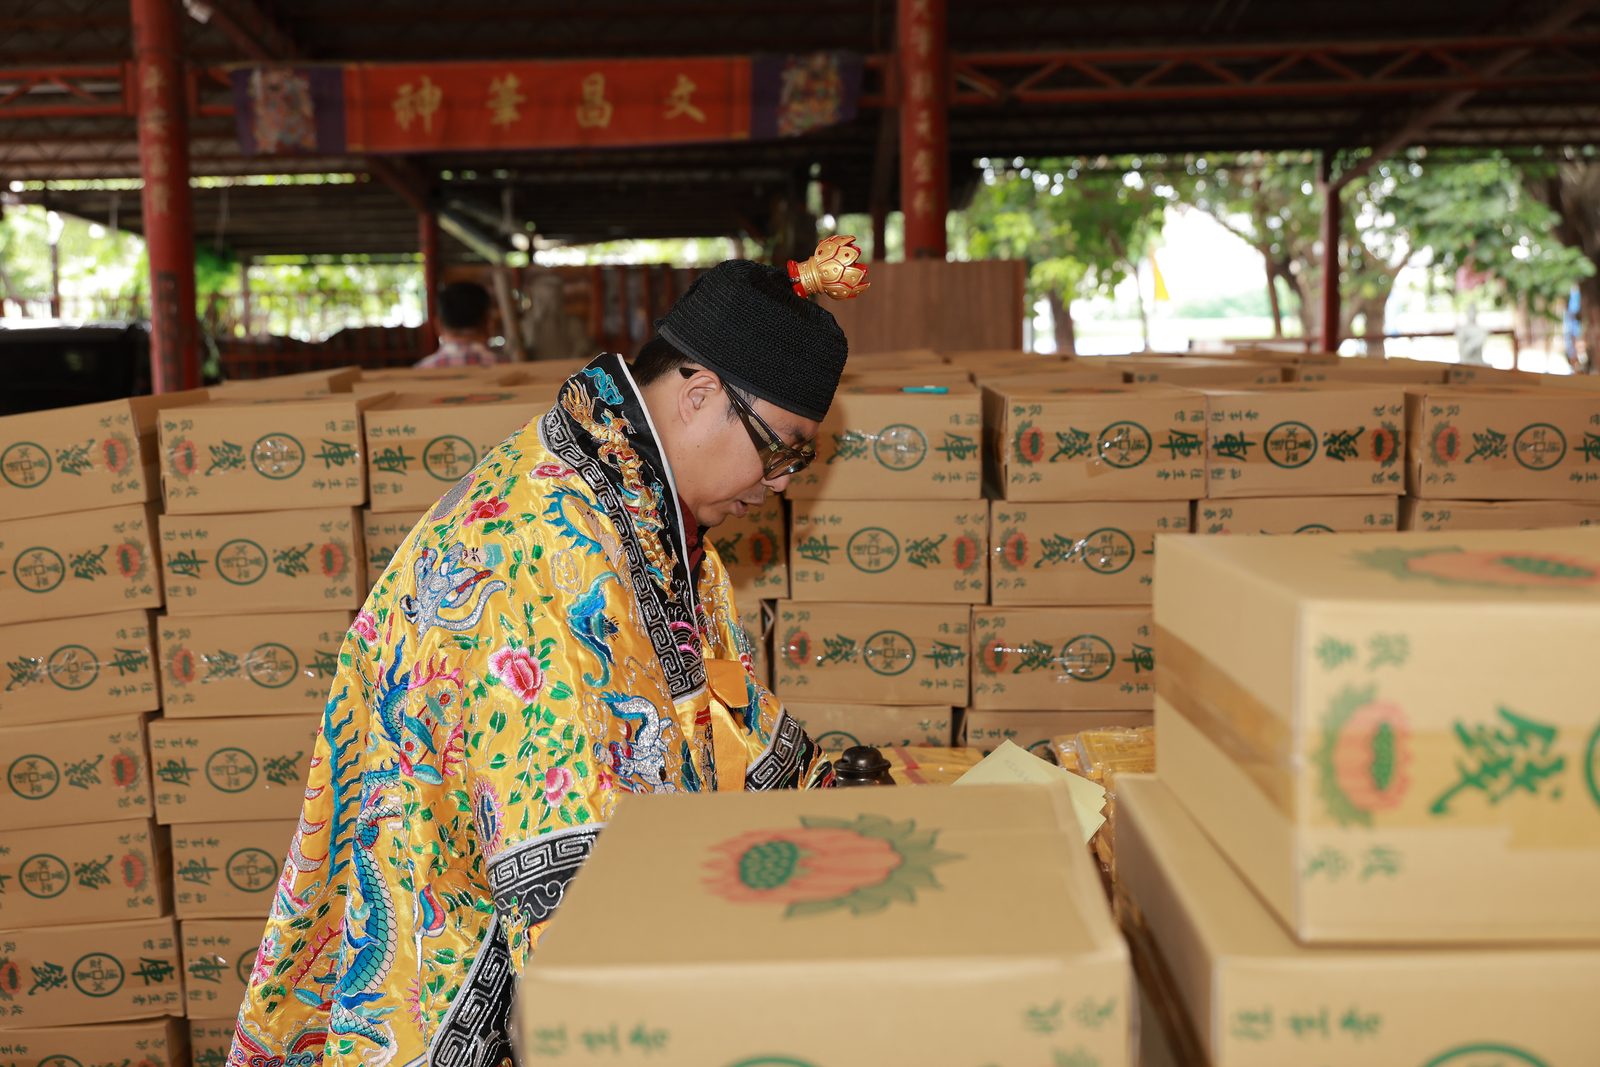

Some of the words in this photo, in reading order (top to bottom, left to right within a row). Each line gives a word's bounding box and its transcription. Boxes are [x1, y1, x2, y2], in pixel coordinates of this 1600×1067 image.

[57, 439, 97, 476] 錢
[204, 440, 247, 477] 錢
[314, 438, 360, 469] 庫
[935, 432, 978, 462] 庫
[1048, 427, 1093, 465] 錢
[1159, 429, 1203, 459] 庫
[1211, 431, 1257, 462] 庫
[1323, 424, 1367, 462] 錢
[1463, 427, 1508, 465] 錢
[372, 446, 416, 477] 庫
[68, 543, 110, 583] 錢
[166, 548, 208, 579] 庫
[272, 542, 315, 578] 錢
[795, 535, 840, 565] 庫
[905, 531, 949, 569] 錢
[1033, 532, 1077, 570] 錢
[108, 645, 149, 678] 庫
[816, 634, 858, 669] 錢
[925, 640, 967, 670] 庫
[1012, 639, 1056, 676] 錢
[63, 752, 105, 791] 錢
[155, 757, 197, 786] 庫
[264, 750, 304, 786] 錢
[1428, 705, 1565, 816] 錢
[74, 853, 114, 890] 錢
[176, 857, 218, 888] 庫
[26, 959, 68, 998] 錢
[131, 958, 177, 986] 庫
[186, 955, 228, 985] 庫
[531, 1022, 669, 1056] 往生者
